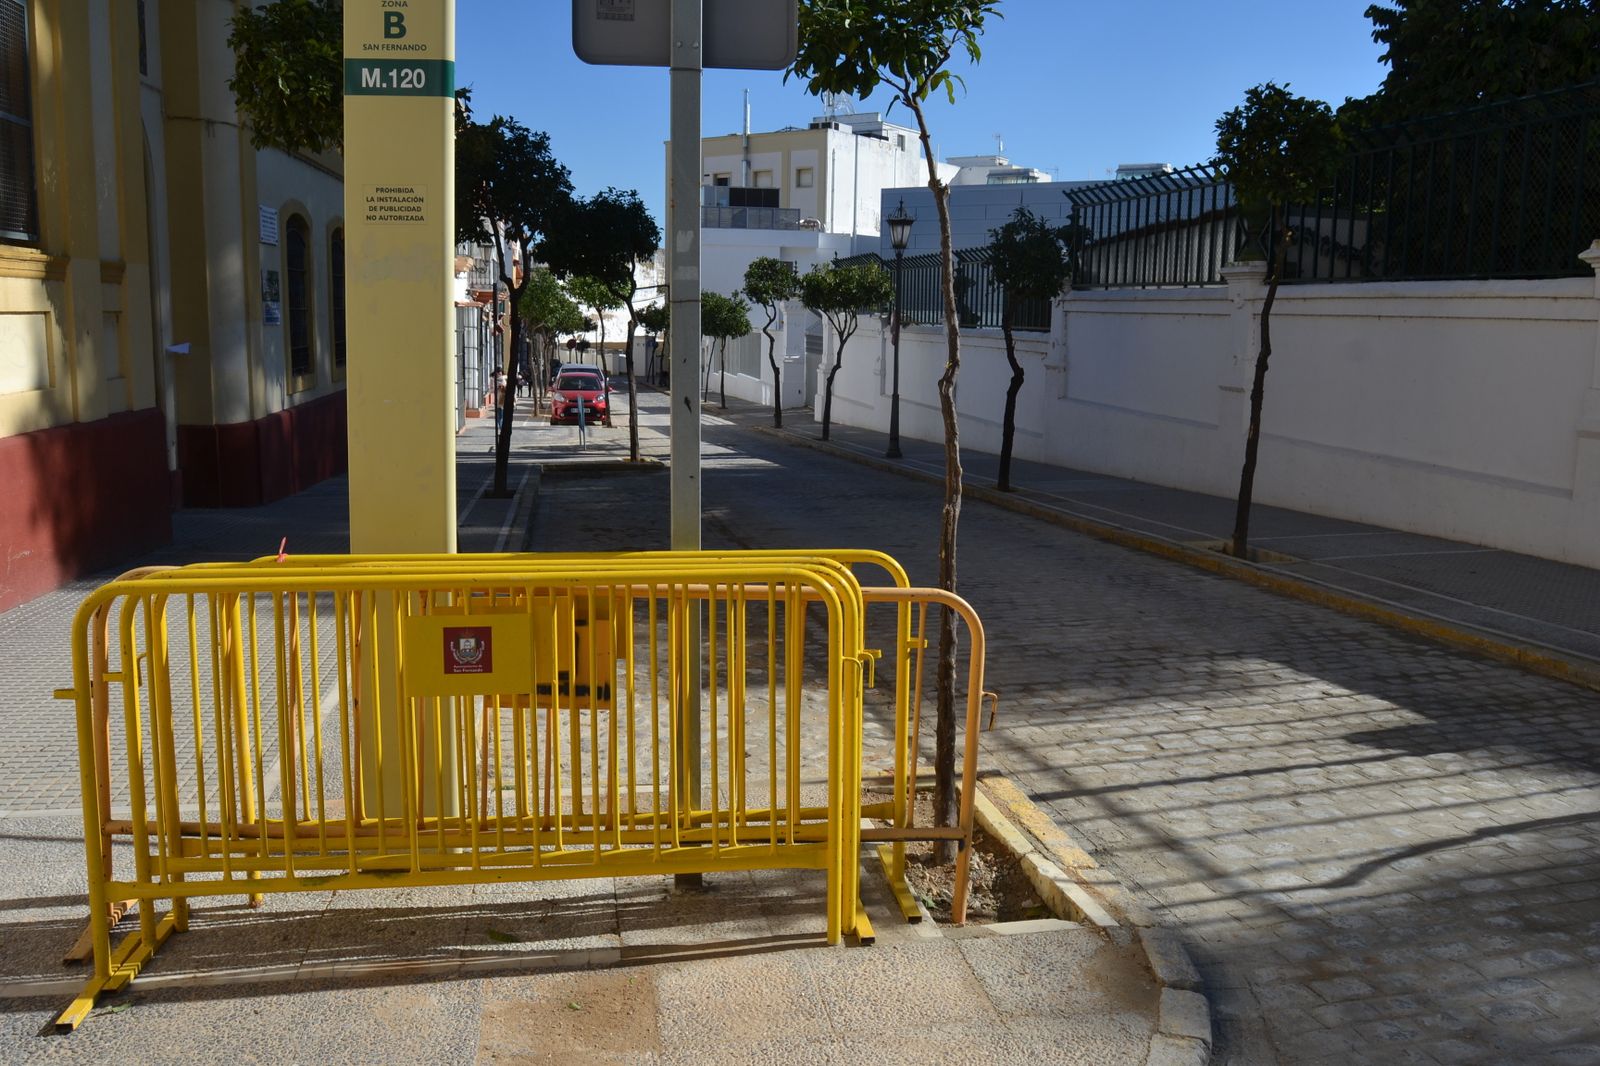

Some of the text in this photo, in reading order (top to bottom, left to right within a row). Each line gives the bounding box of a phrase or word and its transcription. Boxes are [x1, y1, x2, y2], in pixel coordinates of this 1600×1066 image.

[384, 11, 407, 39] B
[362, 43, 427, 51] SAN FERNANDO
[361, 67, 426, 88] M.120
[377, 195, 424, 203] INSTALACIÓN
